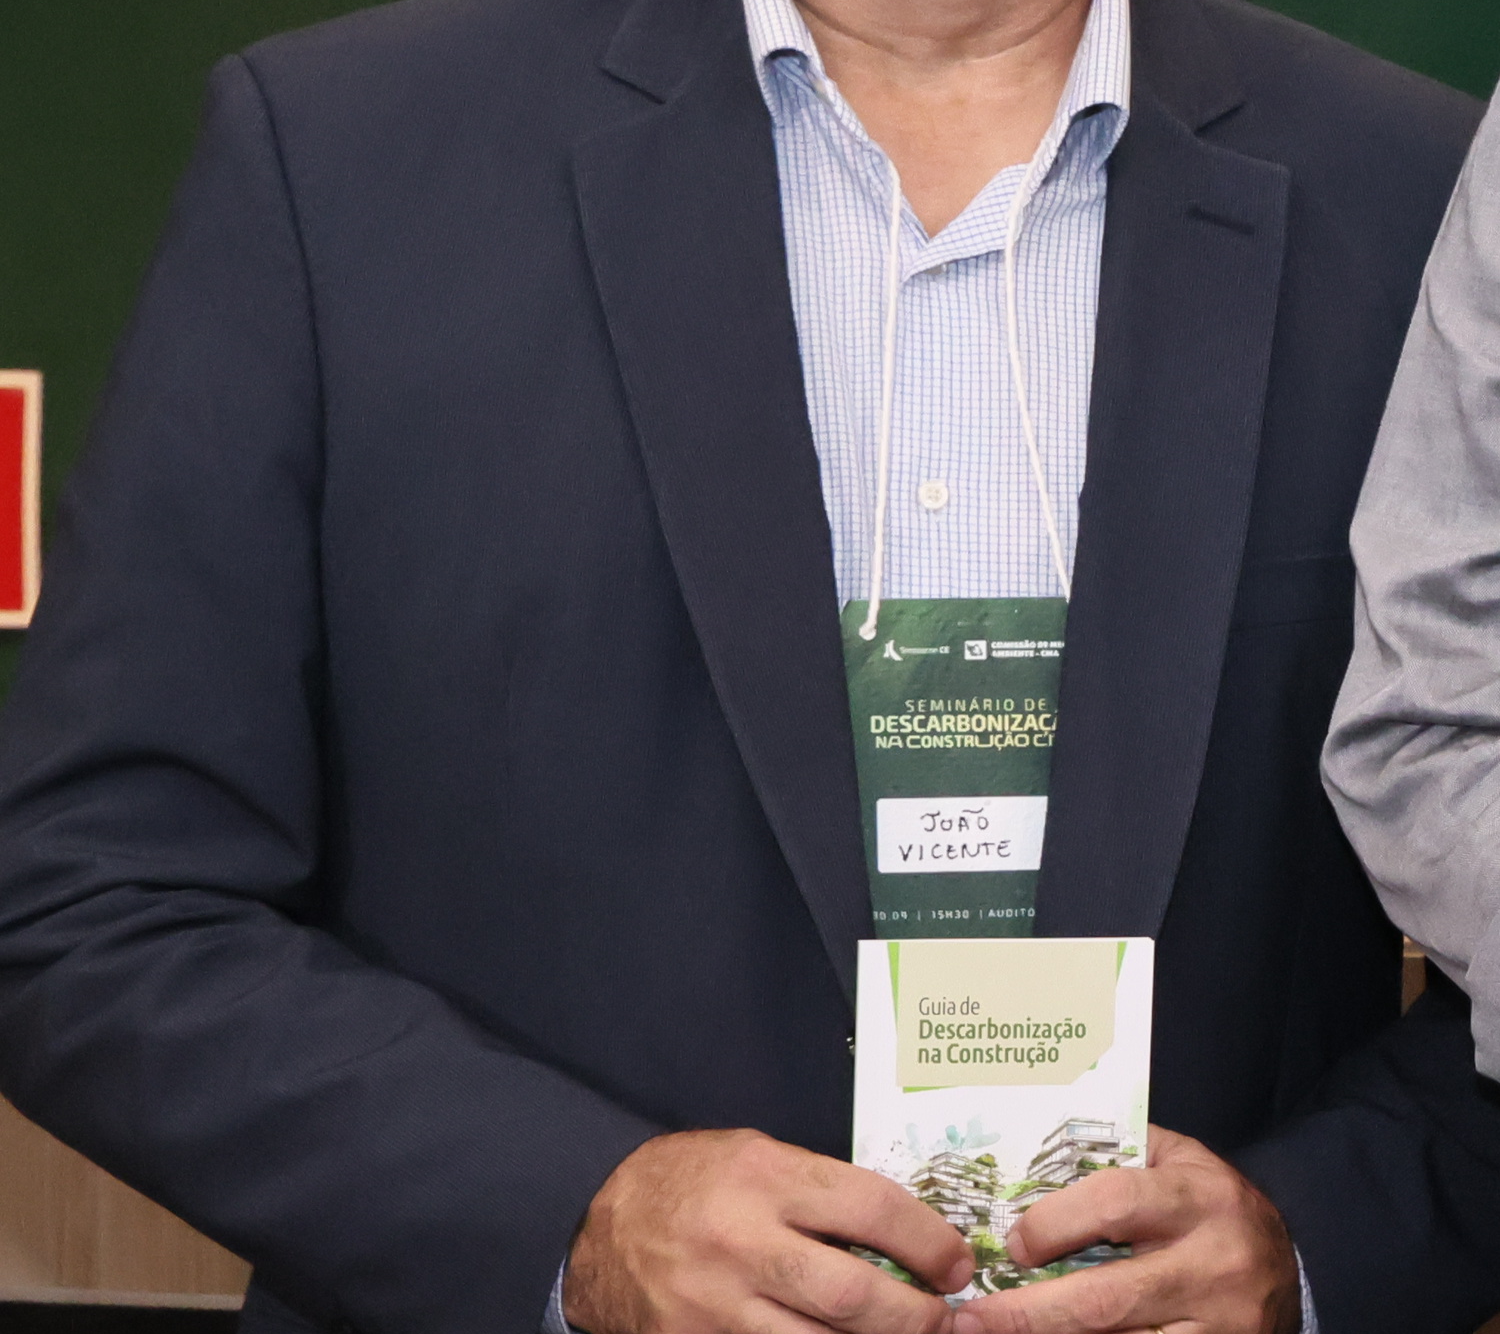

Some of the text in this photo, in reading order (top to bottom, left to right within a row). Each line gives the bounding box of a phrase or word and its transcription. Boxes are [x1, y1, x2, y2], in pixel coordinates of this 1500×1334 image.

[904, 696, 1047, 713] SEMINÁRIO DE
[875, 735, 903, 749] NA
[906, 732, 1030, 750] CONSTRUÇÃO
[898, 839, 1012, 862] VICENTE
[918, 996, 979, 1016] Guia de
[918, 1016, 1086, 1044] Descarbonização
[917, 1042, 1059, 1068] na Construção
